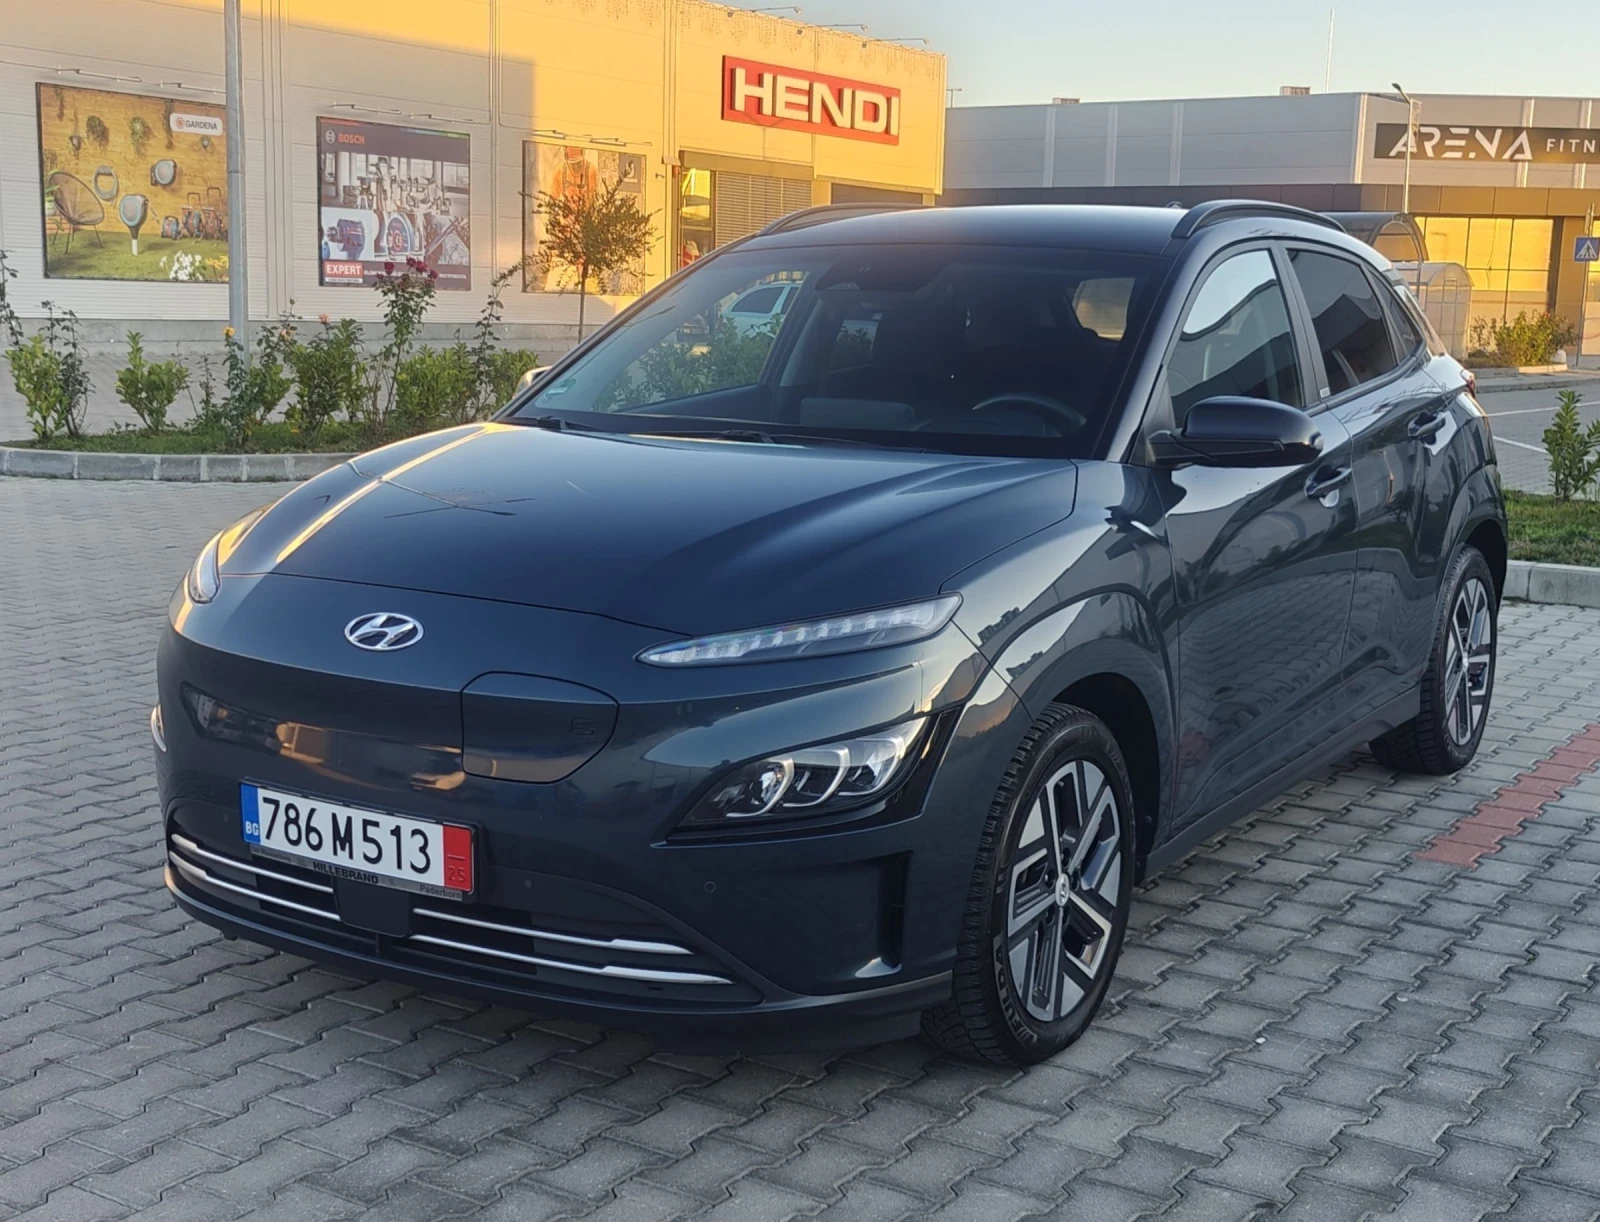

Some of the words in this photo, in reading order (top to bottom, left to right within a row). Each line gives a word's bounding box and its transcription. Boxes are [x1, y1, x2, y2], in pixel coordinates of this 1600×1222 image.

[731, 67, 899, 136] HENDI
[185, 120, 218, 130] GARDENA
[337, 133, 365, 144] BOSCH
[1389, 126, 1533, 160] ARENA
[326, 264, 362, 275] EXPERT
[245, 821, 259, 836] BG
[313, 861, 379, 884] HILLEBRAND
[448, 865, 465, 882] 25
[420, 884, 463, 899] Paderborn
